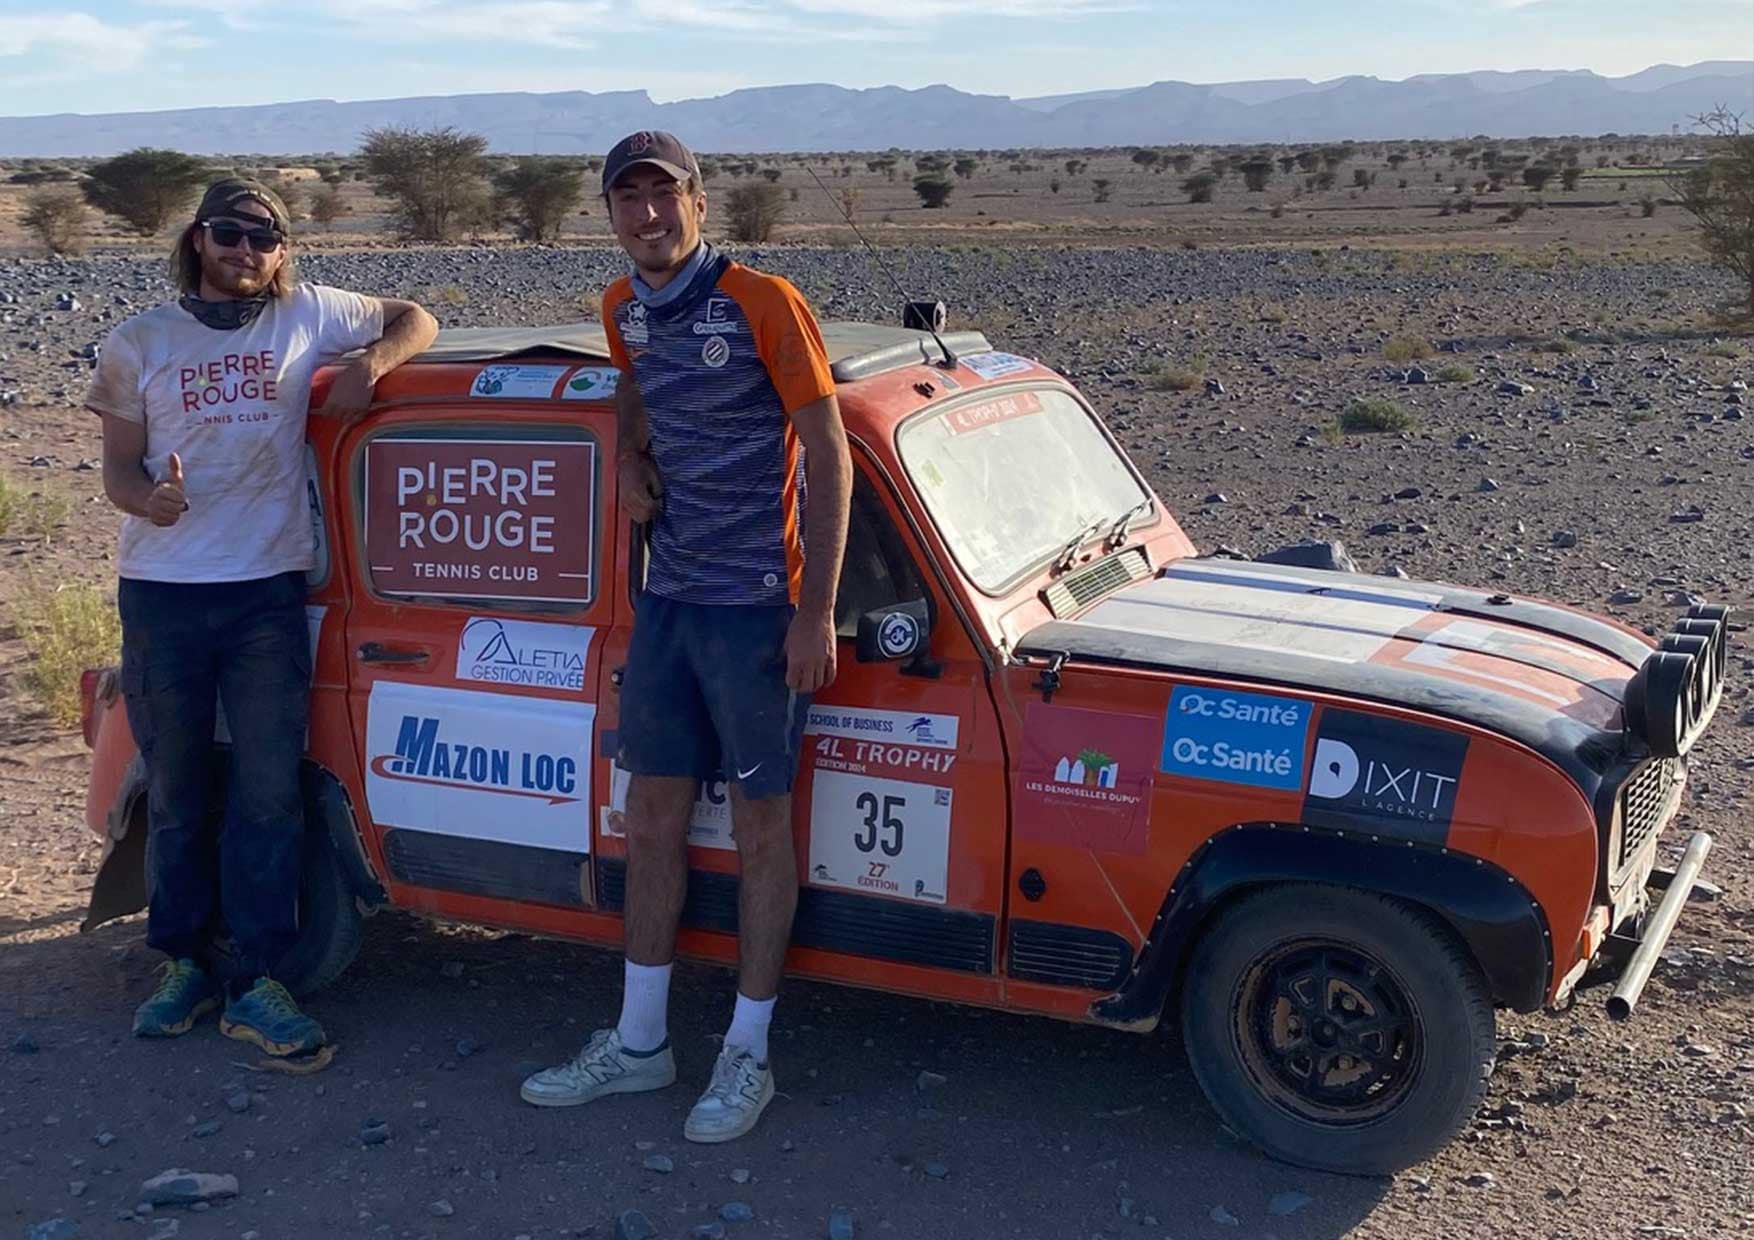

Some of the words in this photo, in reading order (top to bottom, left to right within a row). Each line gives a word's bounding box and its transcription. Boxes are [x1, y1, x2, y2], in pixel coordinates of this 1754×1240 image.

[180, 350, 275, 390] PIERRE
[182, 379, 277, 412] ROUGE
[238, 412, 269, 423] CLUB
[397, 459, 556, 506] PIERRE
[399, 508, 556, 553] ROUGE
[412, 562, 481, 579] TENNIS
[488, 565, 539, 581] CLUB
[471, 664, 533, 683] GESTION
[536, 669, 584, 688] PRIVÉE
[809, 713, 840, 728] SCHOOL
[841, 716, 852, 729] OF
[853, 717, 894, 733] BUSINESS
[1179, 694, 1215, 717] Oc
[1217, 697, 1299, 726] Santé
[391, 715, 510, 786] MAZON
[522, 752, 576, 794] LOC
[816, 737, 844, 758] 4L
[855, 742, 957, 773] TROPHY
[1172, 737, 1208, 765] Oc
[1211, 741, 1293, 776] Santé
[1026, 781, 1043, 792] LES
[1309, 737, 1457, 809] DIXIT
[854, 791, 906, 857] 35
